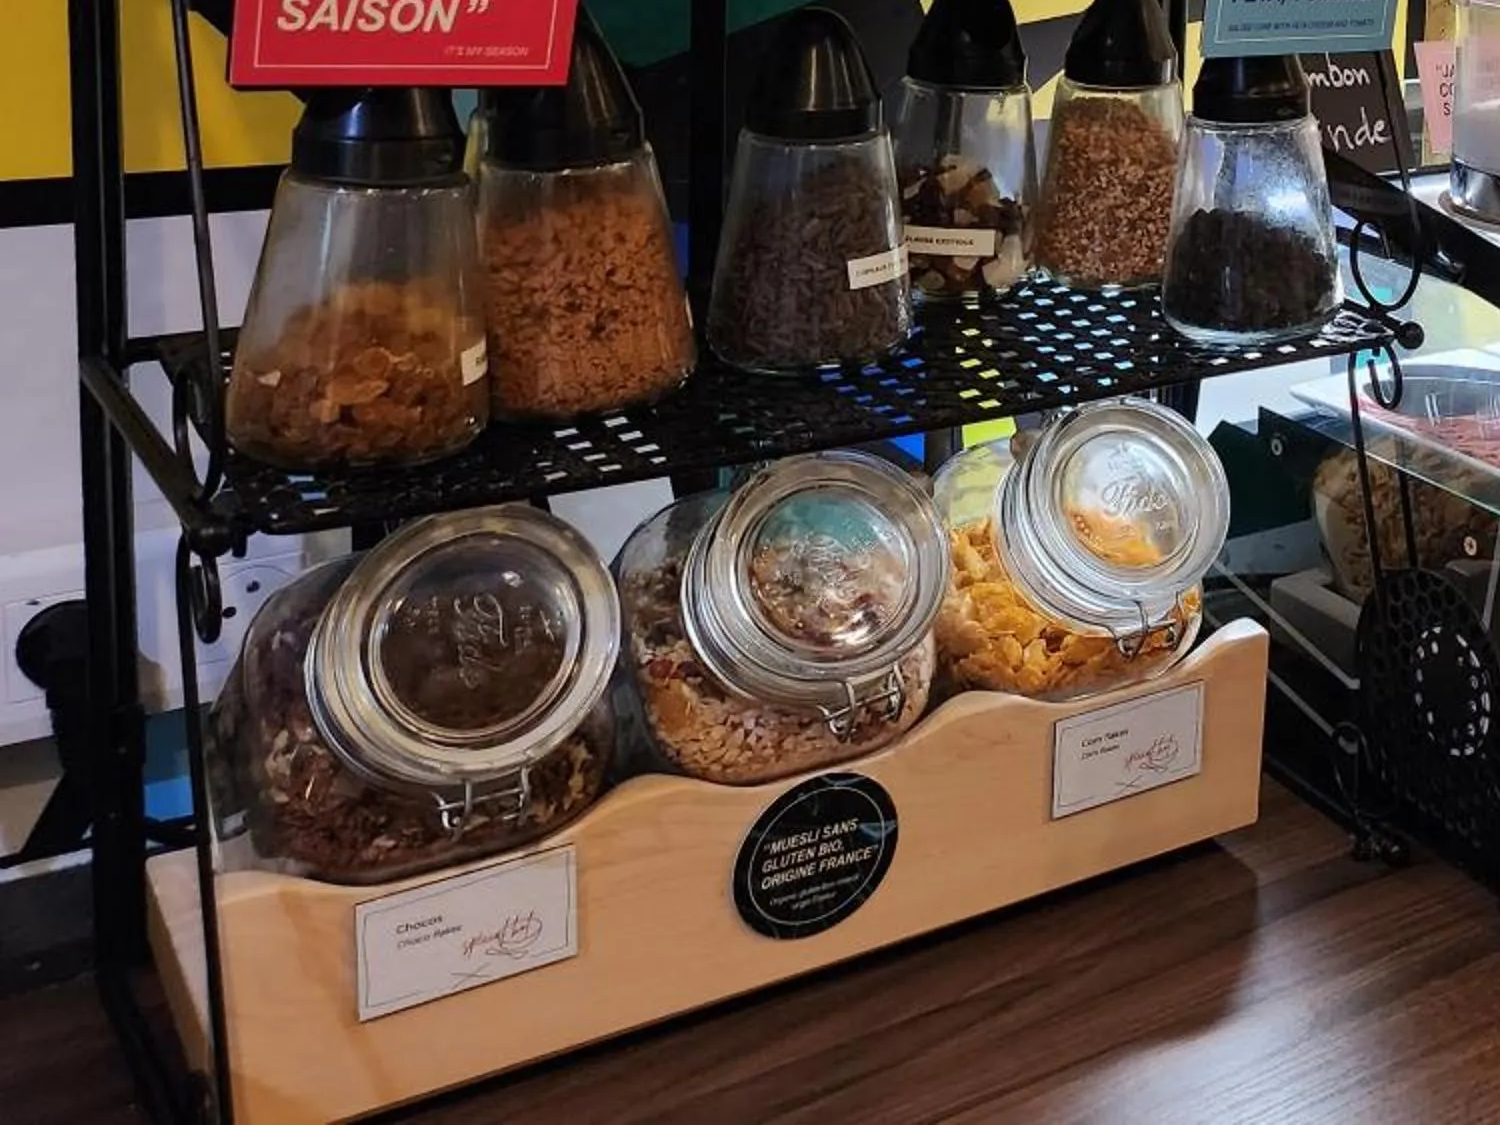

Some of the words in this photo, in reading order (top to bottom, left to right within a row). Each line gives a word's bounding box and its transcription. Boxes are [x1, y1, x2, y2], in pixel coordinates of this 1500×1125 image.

[821, 817, 860, 840] SANS
[761, 849, 816, 874] GLUTEN
[760, 861, 817, 891] ORIGINE
